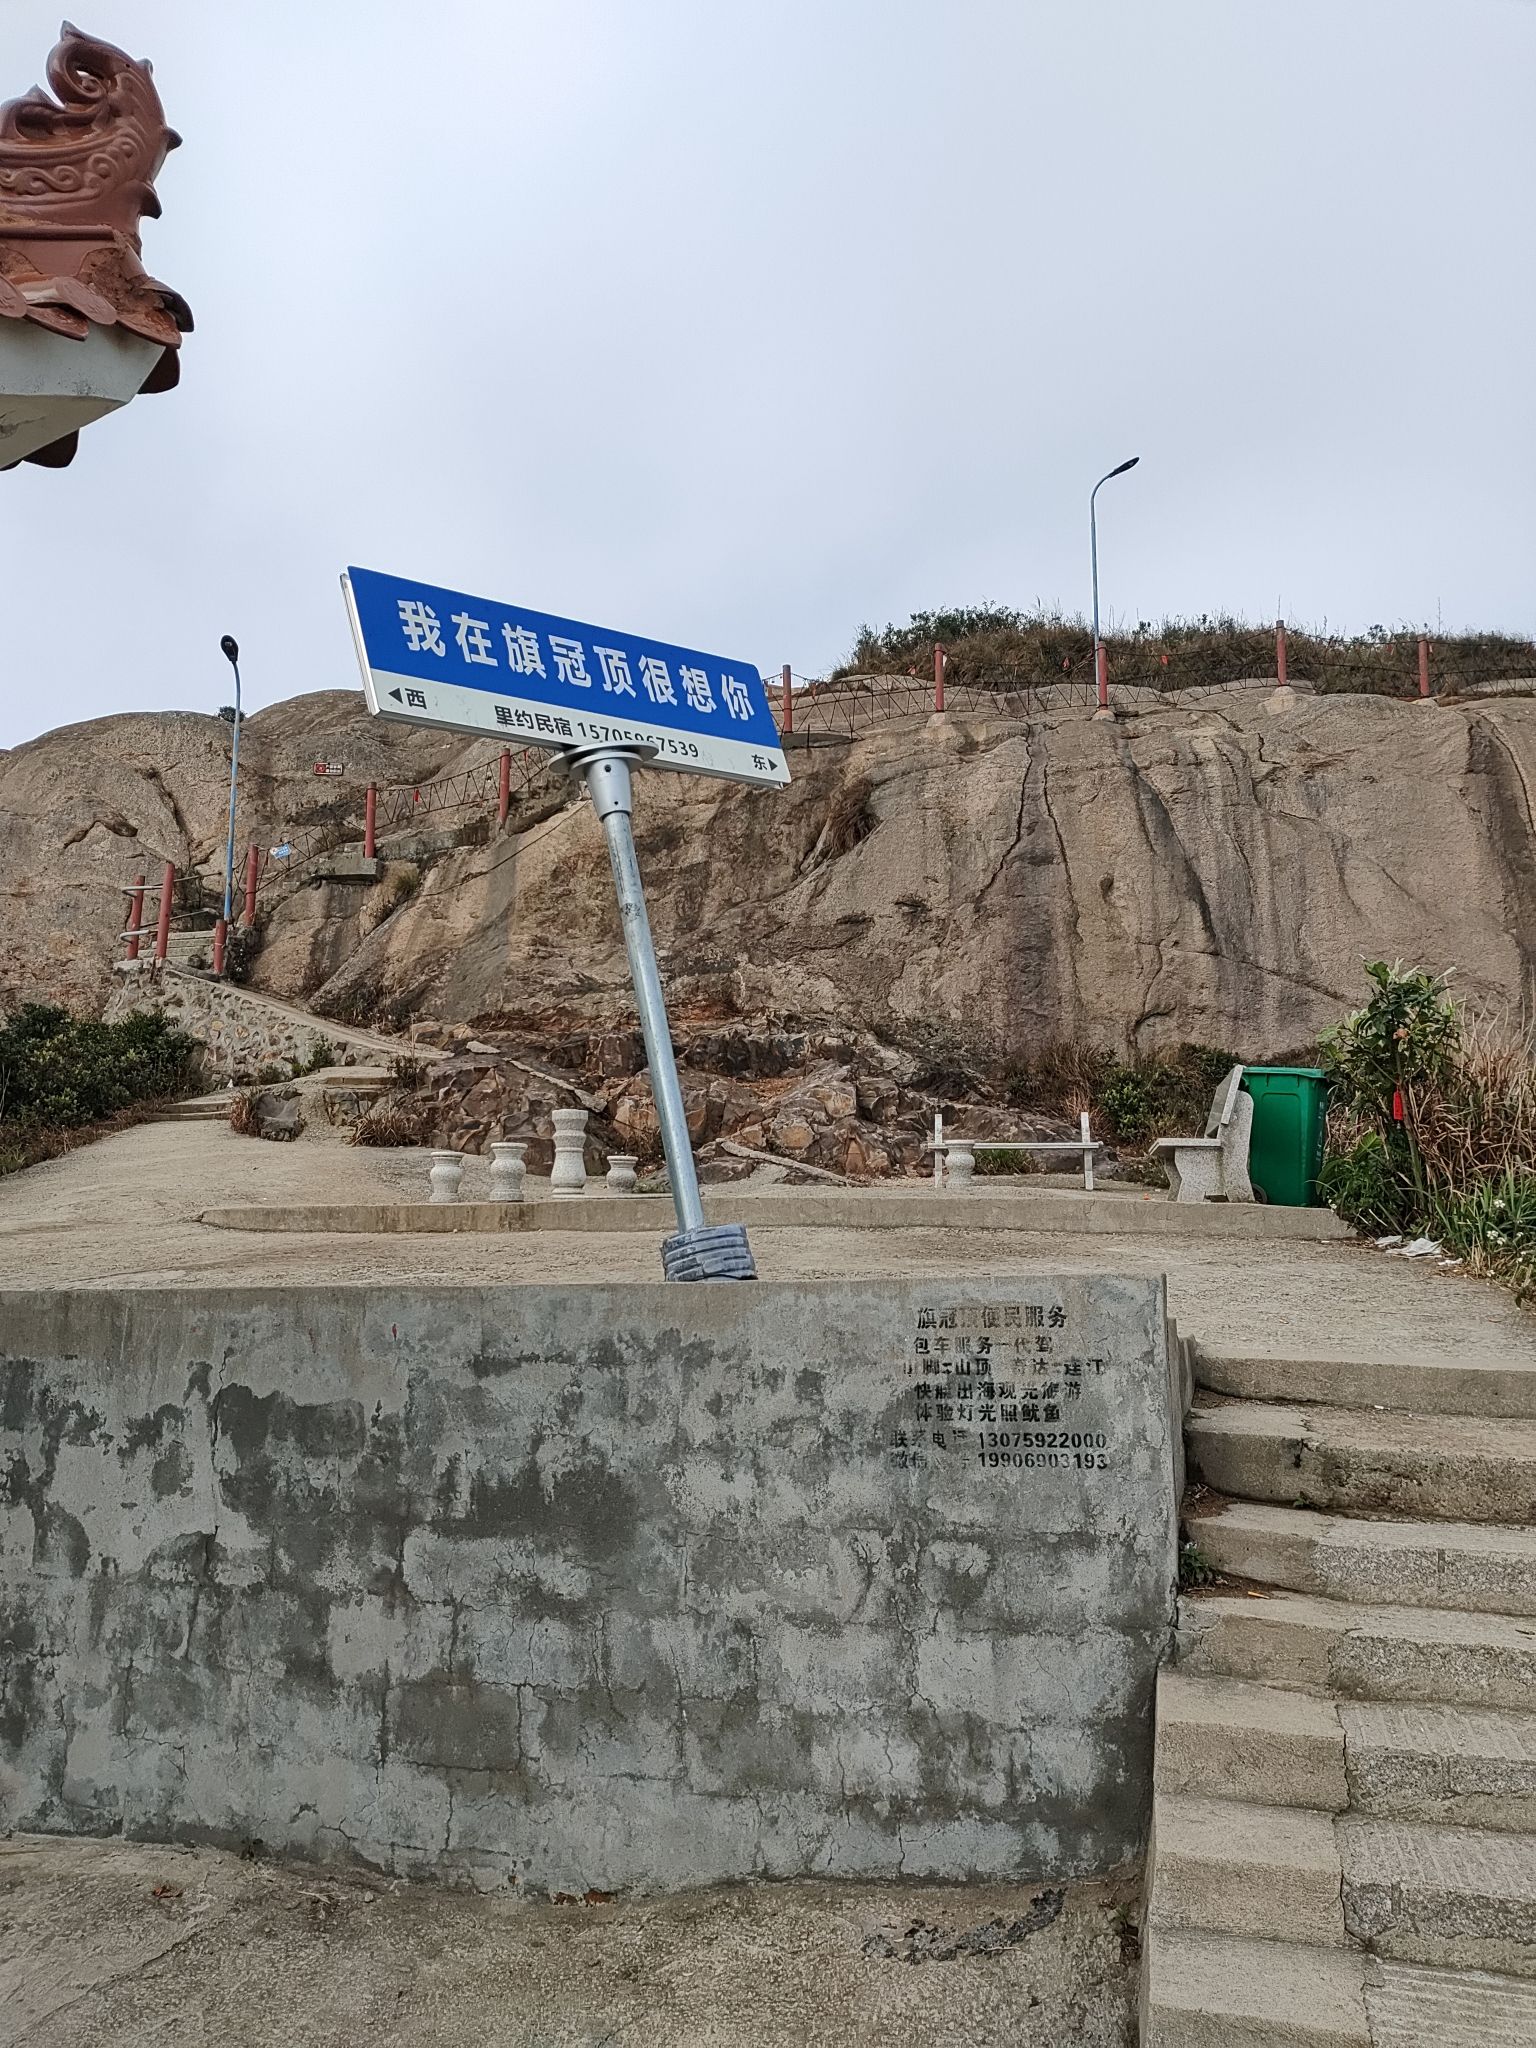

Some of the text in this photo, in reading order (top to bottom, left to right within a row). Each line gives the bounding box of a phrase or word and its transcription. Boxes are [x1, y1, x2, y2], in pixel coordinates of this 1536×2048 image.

[397, 599, 755, 721] 我在旗冠顶很想你
[405, 687, 428, 710] 西
[494, 705, 573, 737] 里约民宿
[751, 754, 768, 771] 东
[917, 1306, 1067, 1329] 旗冠顶便民服务
[915, 1403, 1060, 1422] 体验灯光照鱿鱼
[978, 1432, 1107, 1450] 13075922000
[978, 1452, 1108, 1471] 19906903193
